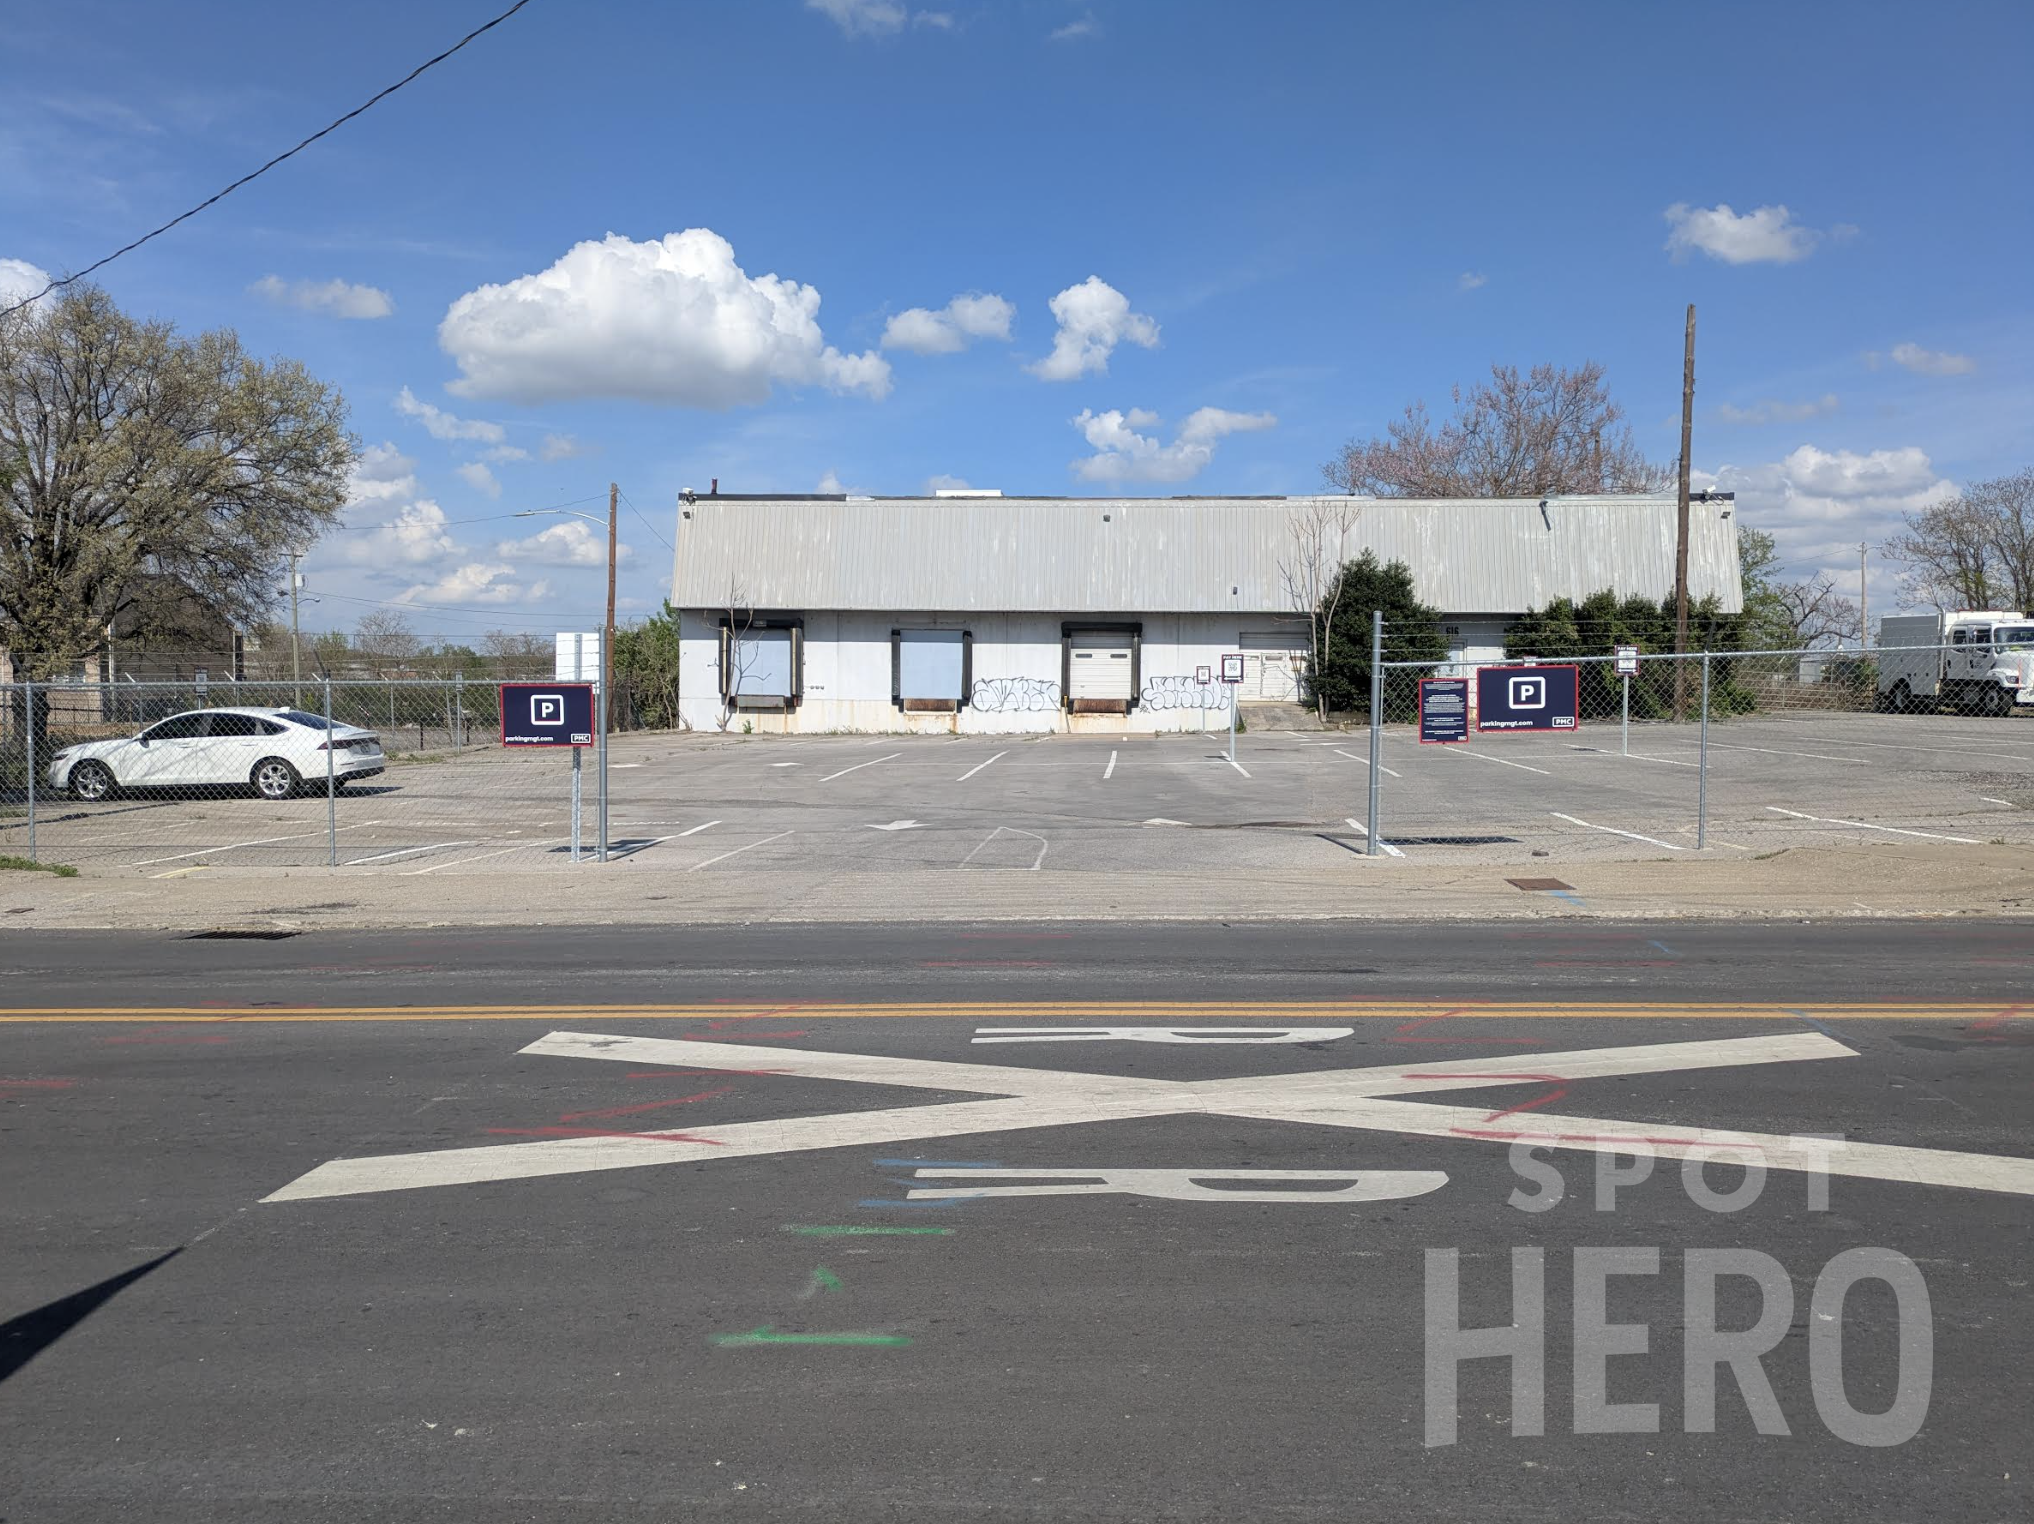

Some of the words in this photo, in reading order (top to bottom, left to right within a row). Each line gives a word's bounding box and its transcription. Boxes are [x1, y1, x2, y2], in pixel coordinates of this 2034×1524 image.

[1520, 685, 1535, 701] P
[541, 702, 554, 718] P
[1480, 720, 1533, 728] parkingmgt.com
[505, 735, 554, 743] parkingmgt.com
